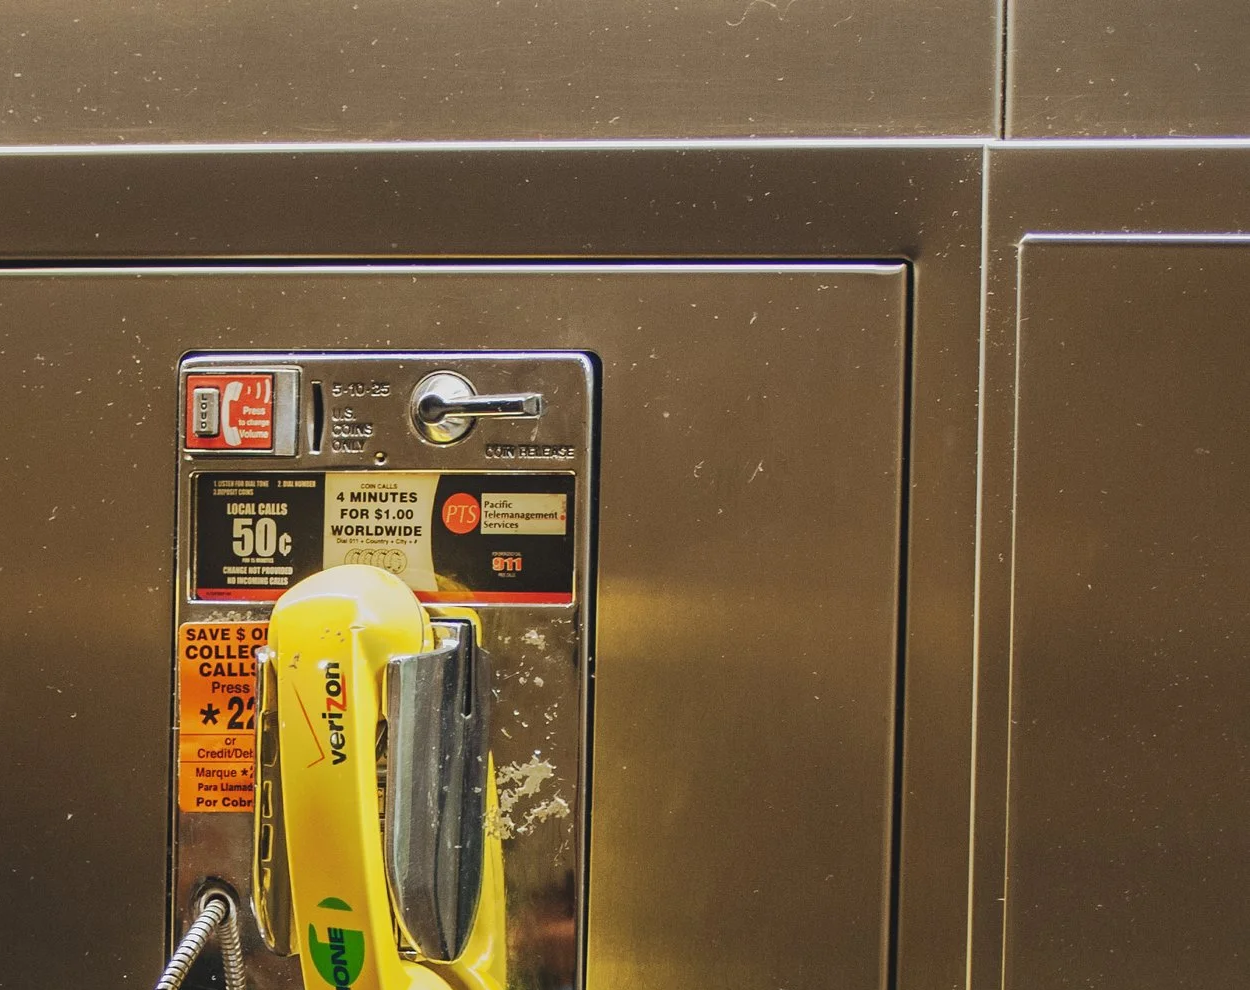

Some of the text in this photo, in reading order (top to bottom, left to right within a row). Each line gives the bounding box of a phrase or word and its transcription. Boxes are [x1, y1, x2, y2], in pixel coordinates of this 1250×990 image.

[332, 382, 390, 397] 5-10-25
[242, 405, 266, 415] Press
[331, 407, 356, 421] U.S.
[246, 419, 270, 427] change
[240, 430, 269, 438] Volume
[331, 424, 373, 437] COINS
[331, 440, 366, 453] ONLY
[485, 443, 575, 460] COIN RELEASE
[336, 492, 418, 503] 4 MINUTES
[227, 503, 288, 515] LOCAL CALLS
[484, 500, 513, 508] Pacific
[340, 508, 414, 520] FOR $1.00
[445, 505, 478, 524] PTS
[484, 510, 558, 520] Telemanagement
[331, 525, 422, 536] WORLDWIDE
[483, 521, 519, 529] Services
[232, 517, 292, 557] 50¢
[492, 556, 522, 571] 911
[223, 566, 294, 575] CHANGE NOT PROVIDED
[227, 577, 289, 585] NO INCOMING CALLS
[186, 628, 230, 640] SAVE
[236, 627, 246, 642] $
[211, 681, 250, 694] Press
[322, 662, 347, 765] verizon
[225, 738, 236, 746] or
[196, 767, 237, 779] Marque
[198, 783, 218, 791] Para
[196, 797, 218, 807] Por
